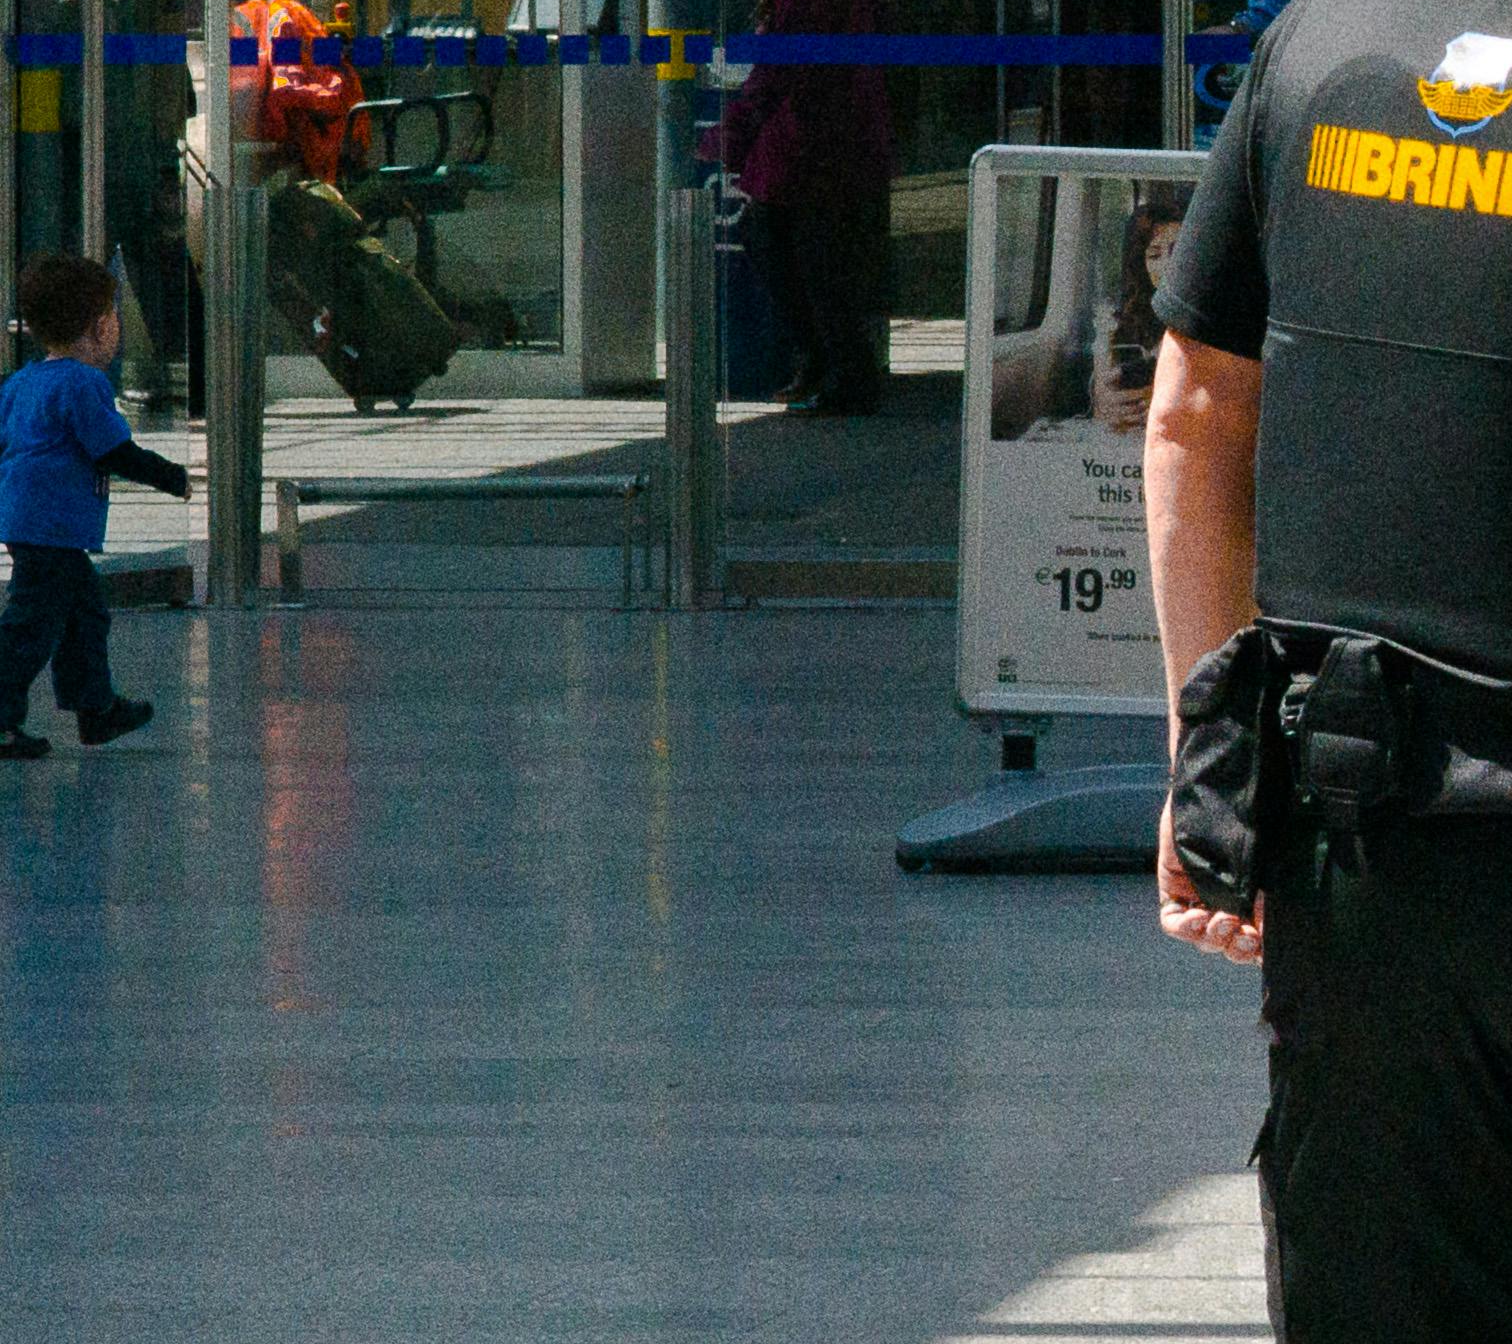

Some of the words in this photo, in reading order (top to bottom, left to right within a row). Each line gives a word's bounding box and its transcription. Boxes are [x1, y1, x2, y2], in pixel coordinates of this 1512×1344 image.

[1082, 458, 1116, 479] You
[1121, 463, 1144, 480] ca
[1098, 483, 1133, 504] this
